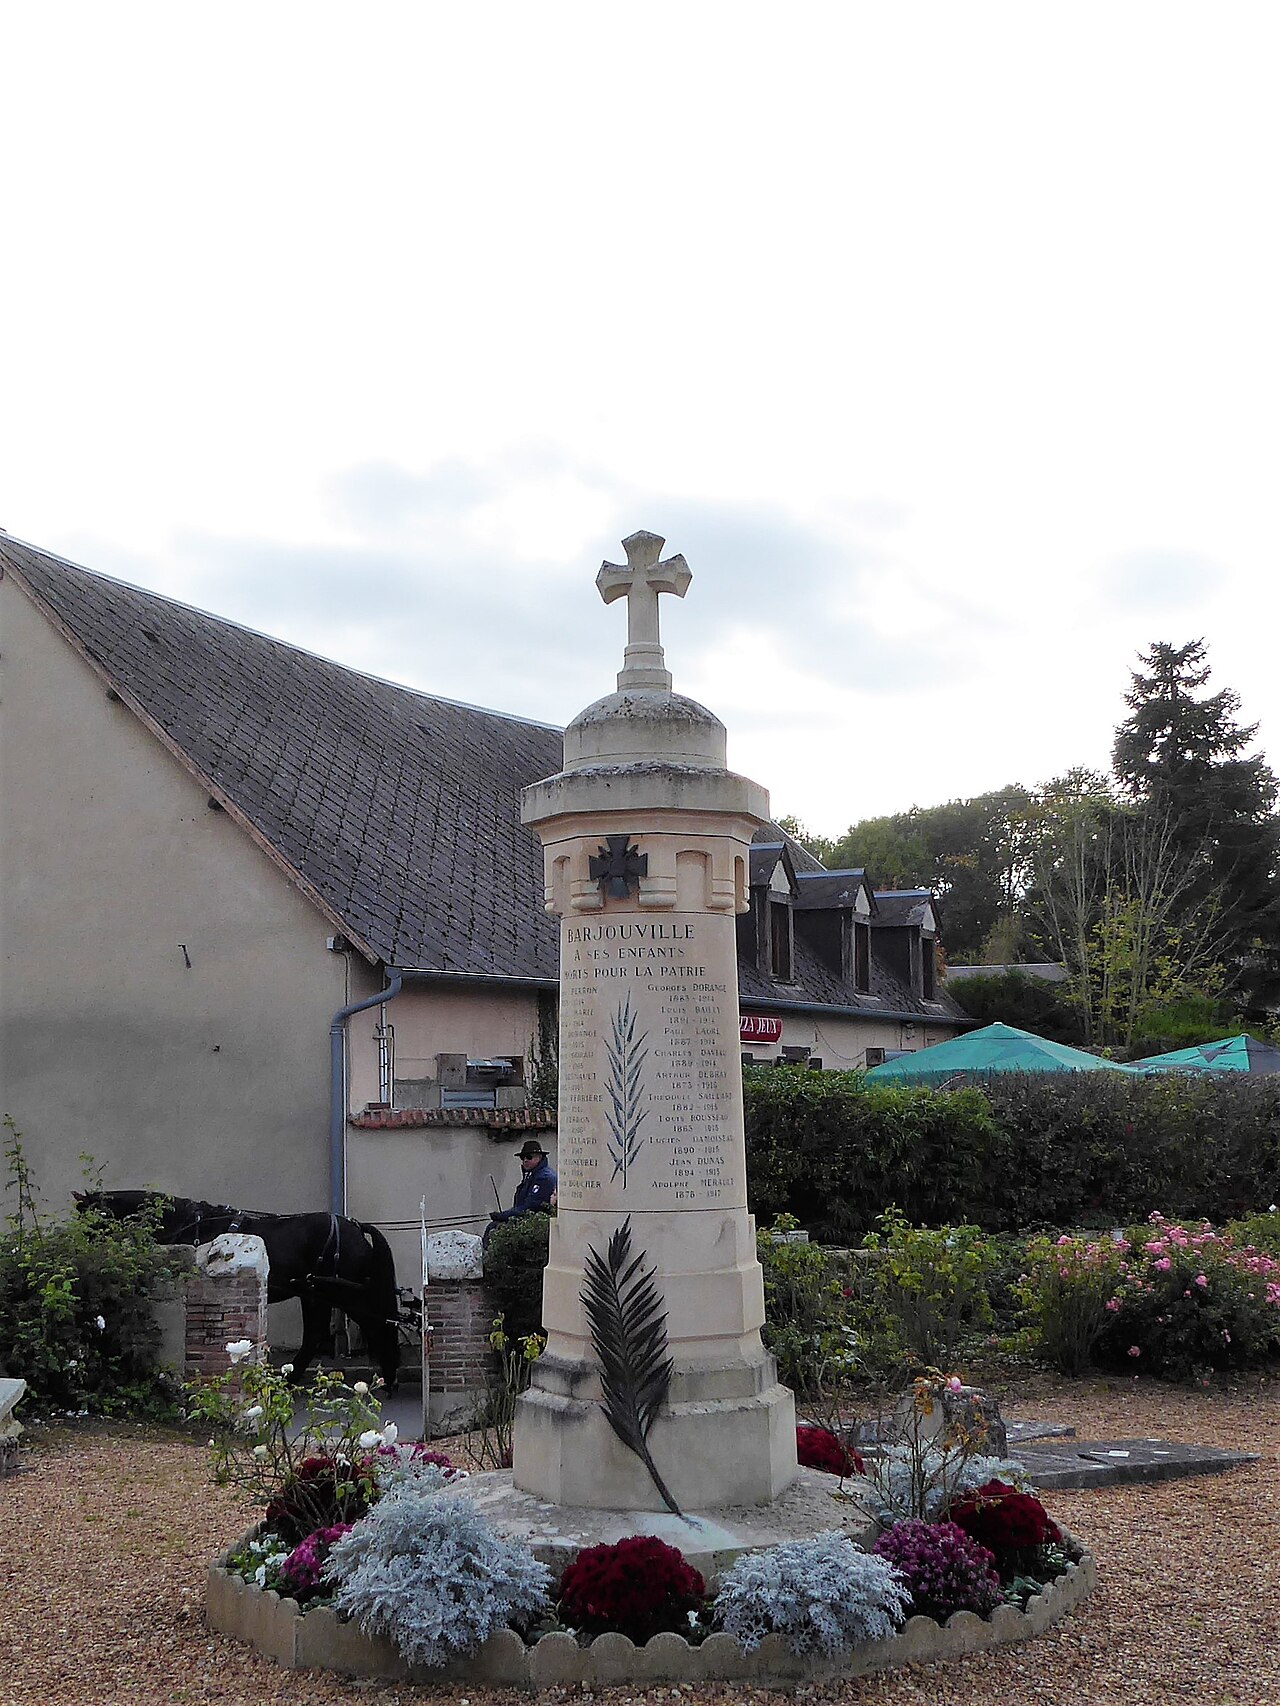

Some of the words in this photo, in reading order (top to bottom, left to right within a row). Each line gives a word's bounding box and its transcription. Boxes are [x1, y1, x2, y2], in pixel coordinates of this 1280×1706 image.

[568, 924, 695, 943] BARJOUVILLE
[587, 949, 610, 960] SES
[618, 947, 685, 959] ENFANTS
[594, 967, 627, 978] POUR
[635, 966, 653, 977] LA
[661, 966, 706, 977] PATRIE
[757, 1017, 777, 1034] JEUX
